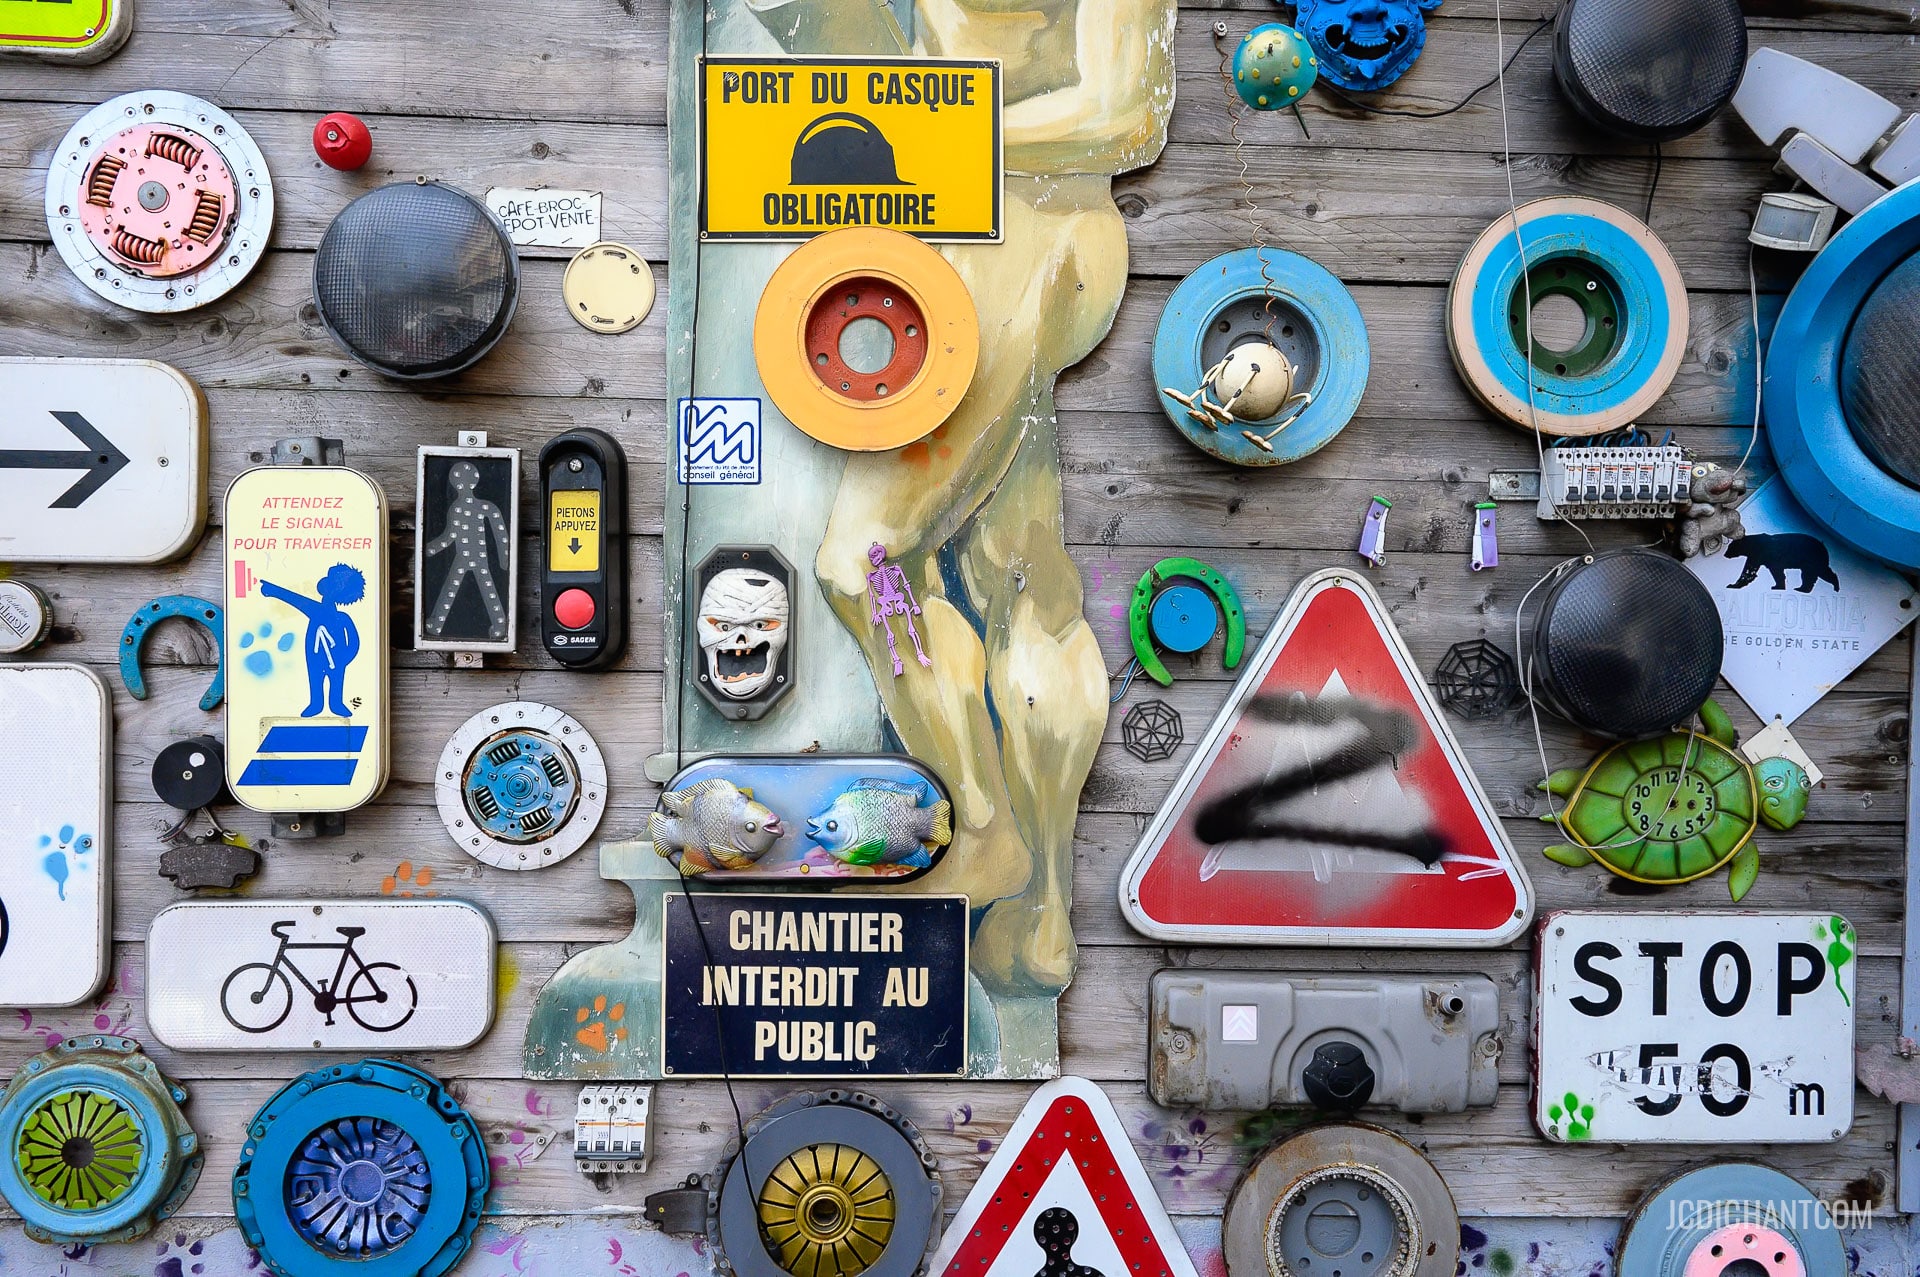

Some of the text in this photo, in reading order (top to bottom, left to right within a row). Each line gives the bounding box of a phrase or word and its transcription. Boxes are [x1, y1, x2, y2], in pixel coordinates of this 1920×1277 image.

[722, 71, 975, 112] PORT DU CASQUE
[763, 192, 936, 225] OBLIGATOIRE
[683, 470, 755, 481] conseil général
[262, 497, 344, 509] ATTENDEZ
[556, 507, 595, 518] PIETONS
[261, 517, 344, 529] LE SIGNAL
[554, 521, 597, 531] APPUYEZ
[233, 538, 373, 550] POUR TRAVERSER
[570, 636, 597, 644] SAGEM
[1745, 636, 1803, 649] GOLDEN
[1811, 639, 1860, 651] STATE
[1650, 772, 1660, 787] 11
[1665, 770, 1680, 783] 12
[1684, 775, 1690, 787] 1
[1635, 784, 1650, 798] 10
[1696, 781, 1705, 794] 2
[1631, 801, 1641, 816] 9
[1704, 797, 1713, 811] 3
[1640, 814, 1649, 831] 8
[1685, 819, 1694, 834] 5
[1695, 813, 1706, 826] 4
[1656, 822, 1664, 837] 7
[1669, 824, 1679, 838] 6
[729, 909, 903, 953] CHANTIER
[1568, 940, 1827, 1017] STOP
[702, 965, 929, 1007] INTERDIT AU
[754, 1020, 877, 1062] PUBLIC
[1635, 1043, 1825, 1118] 50 m
